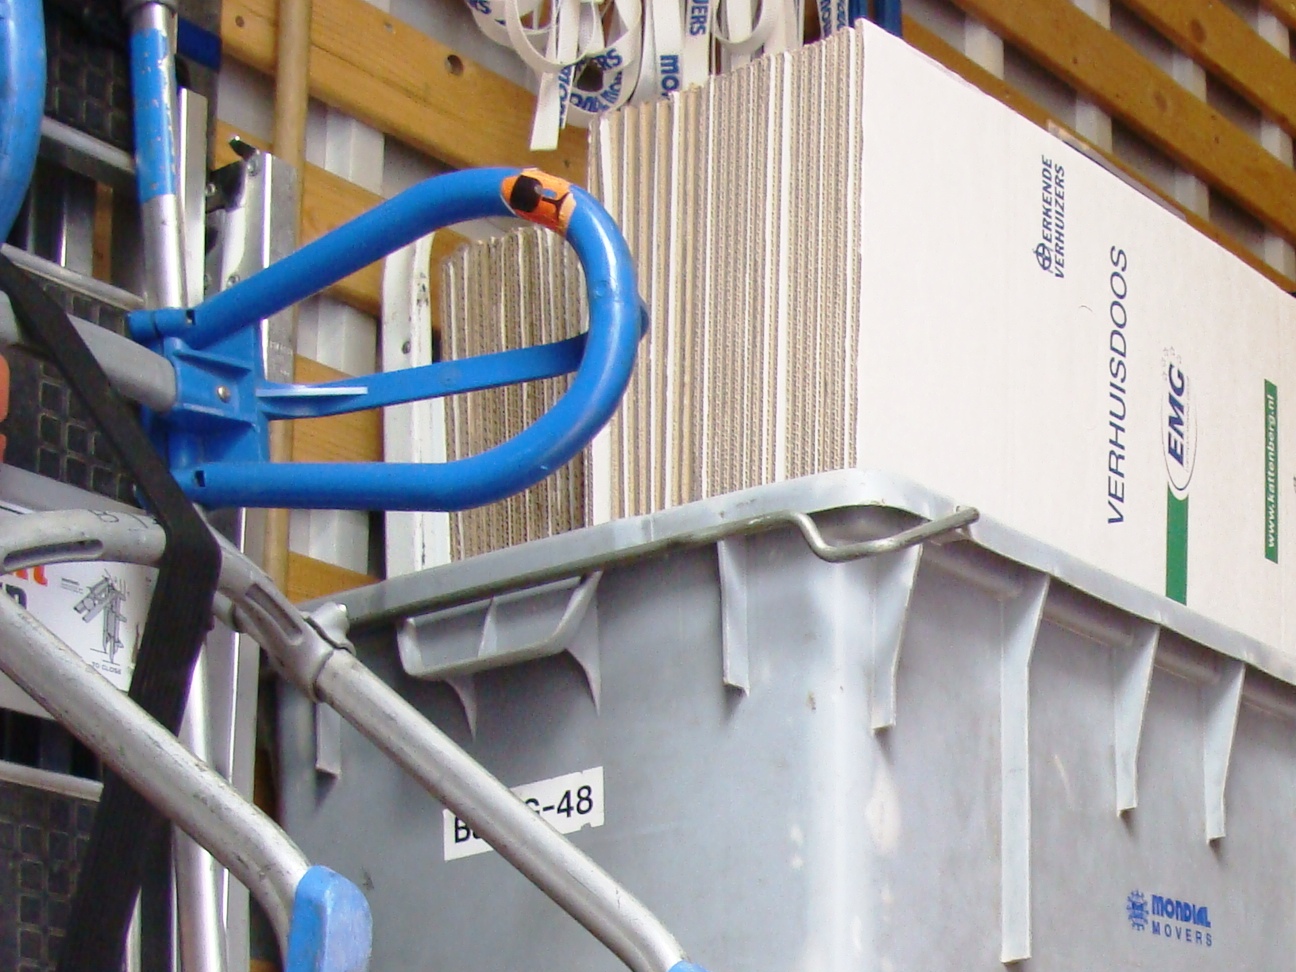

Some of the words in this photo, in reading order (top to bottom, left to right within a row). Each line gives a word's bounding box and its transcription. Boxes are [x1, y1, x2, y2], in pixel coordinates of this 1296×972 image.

[1041, 154, 1053, 244] ERKENDE
[1054, 163, 1066, 279] VERHUIZERS
[1107, 246, 1128, 525] VERHUISDOOS
[1167, 363, 1186, 468] EMG
[1266, 394, 1276, 548] www.kattenberg.nl
[1151, 893, 1211, 928] MONDIAL
[1152, 920, 1212, 947] MOVERS
